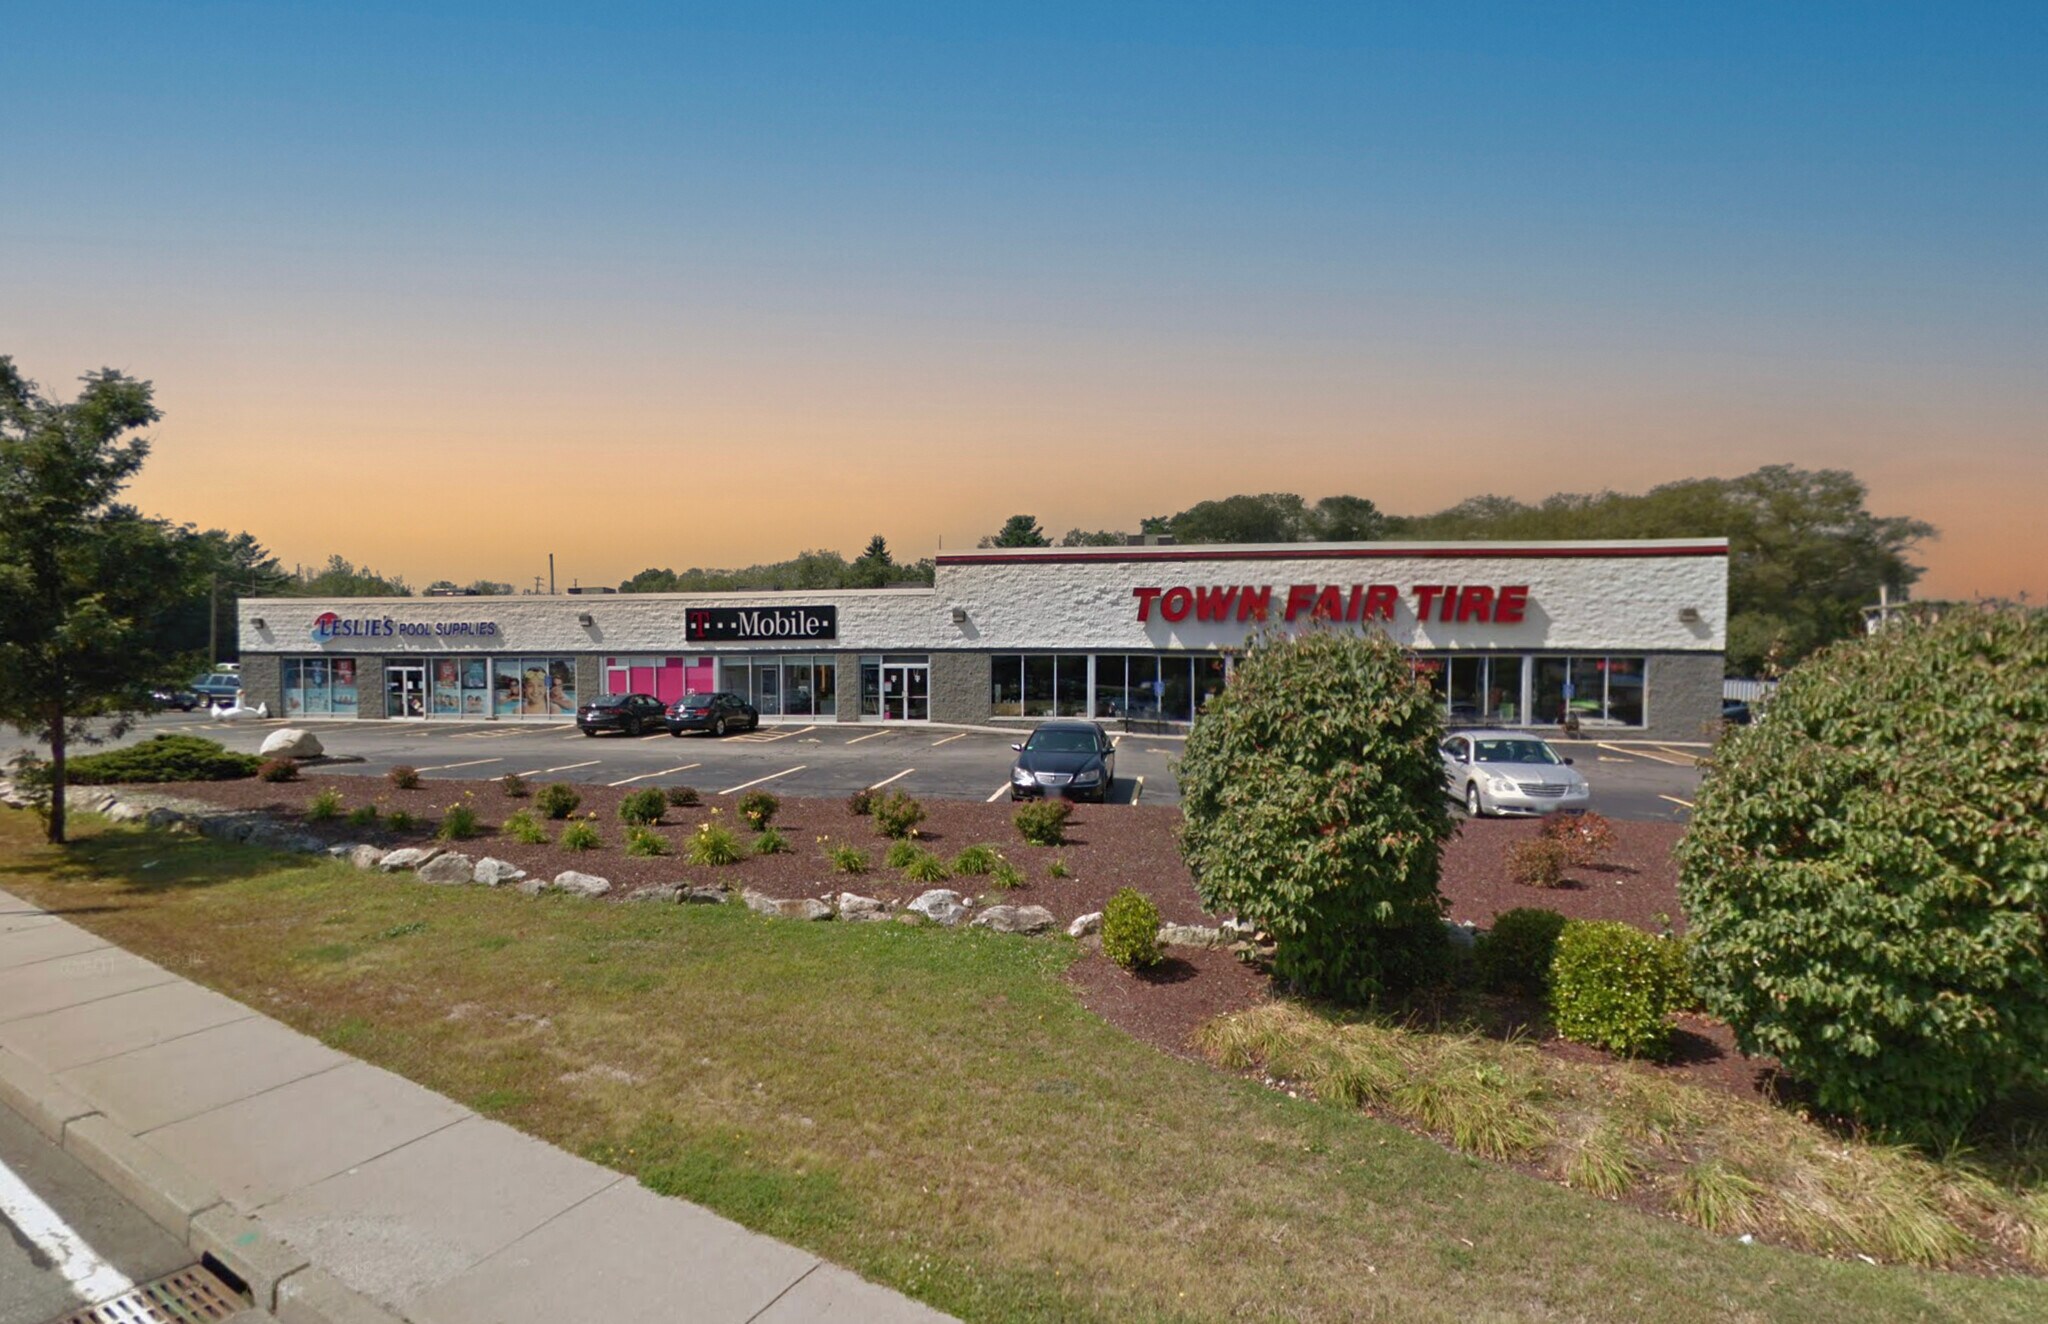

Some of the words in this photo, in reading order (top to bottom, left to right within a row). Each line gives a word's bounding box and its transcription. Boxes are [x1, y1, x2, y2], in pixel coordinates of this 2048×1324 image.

[1134, 586, 1272, 622] TOWN
[1286, 586, 1399, 621] FAIR
[1414, 586, 1529, 622] TIRE
[320, 615, 395, 637] LESLIE'S
[398, 623, 431, 636] POOL
[435, 621, 497, 636] SUPPLIES
